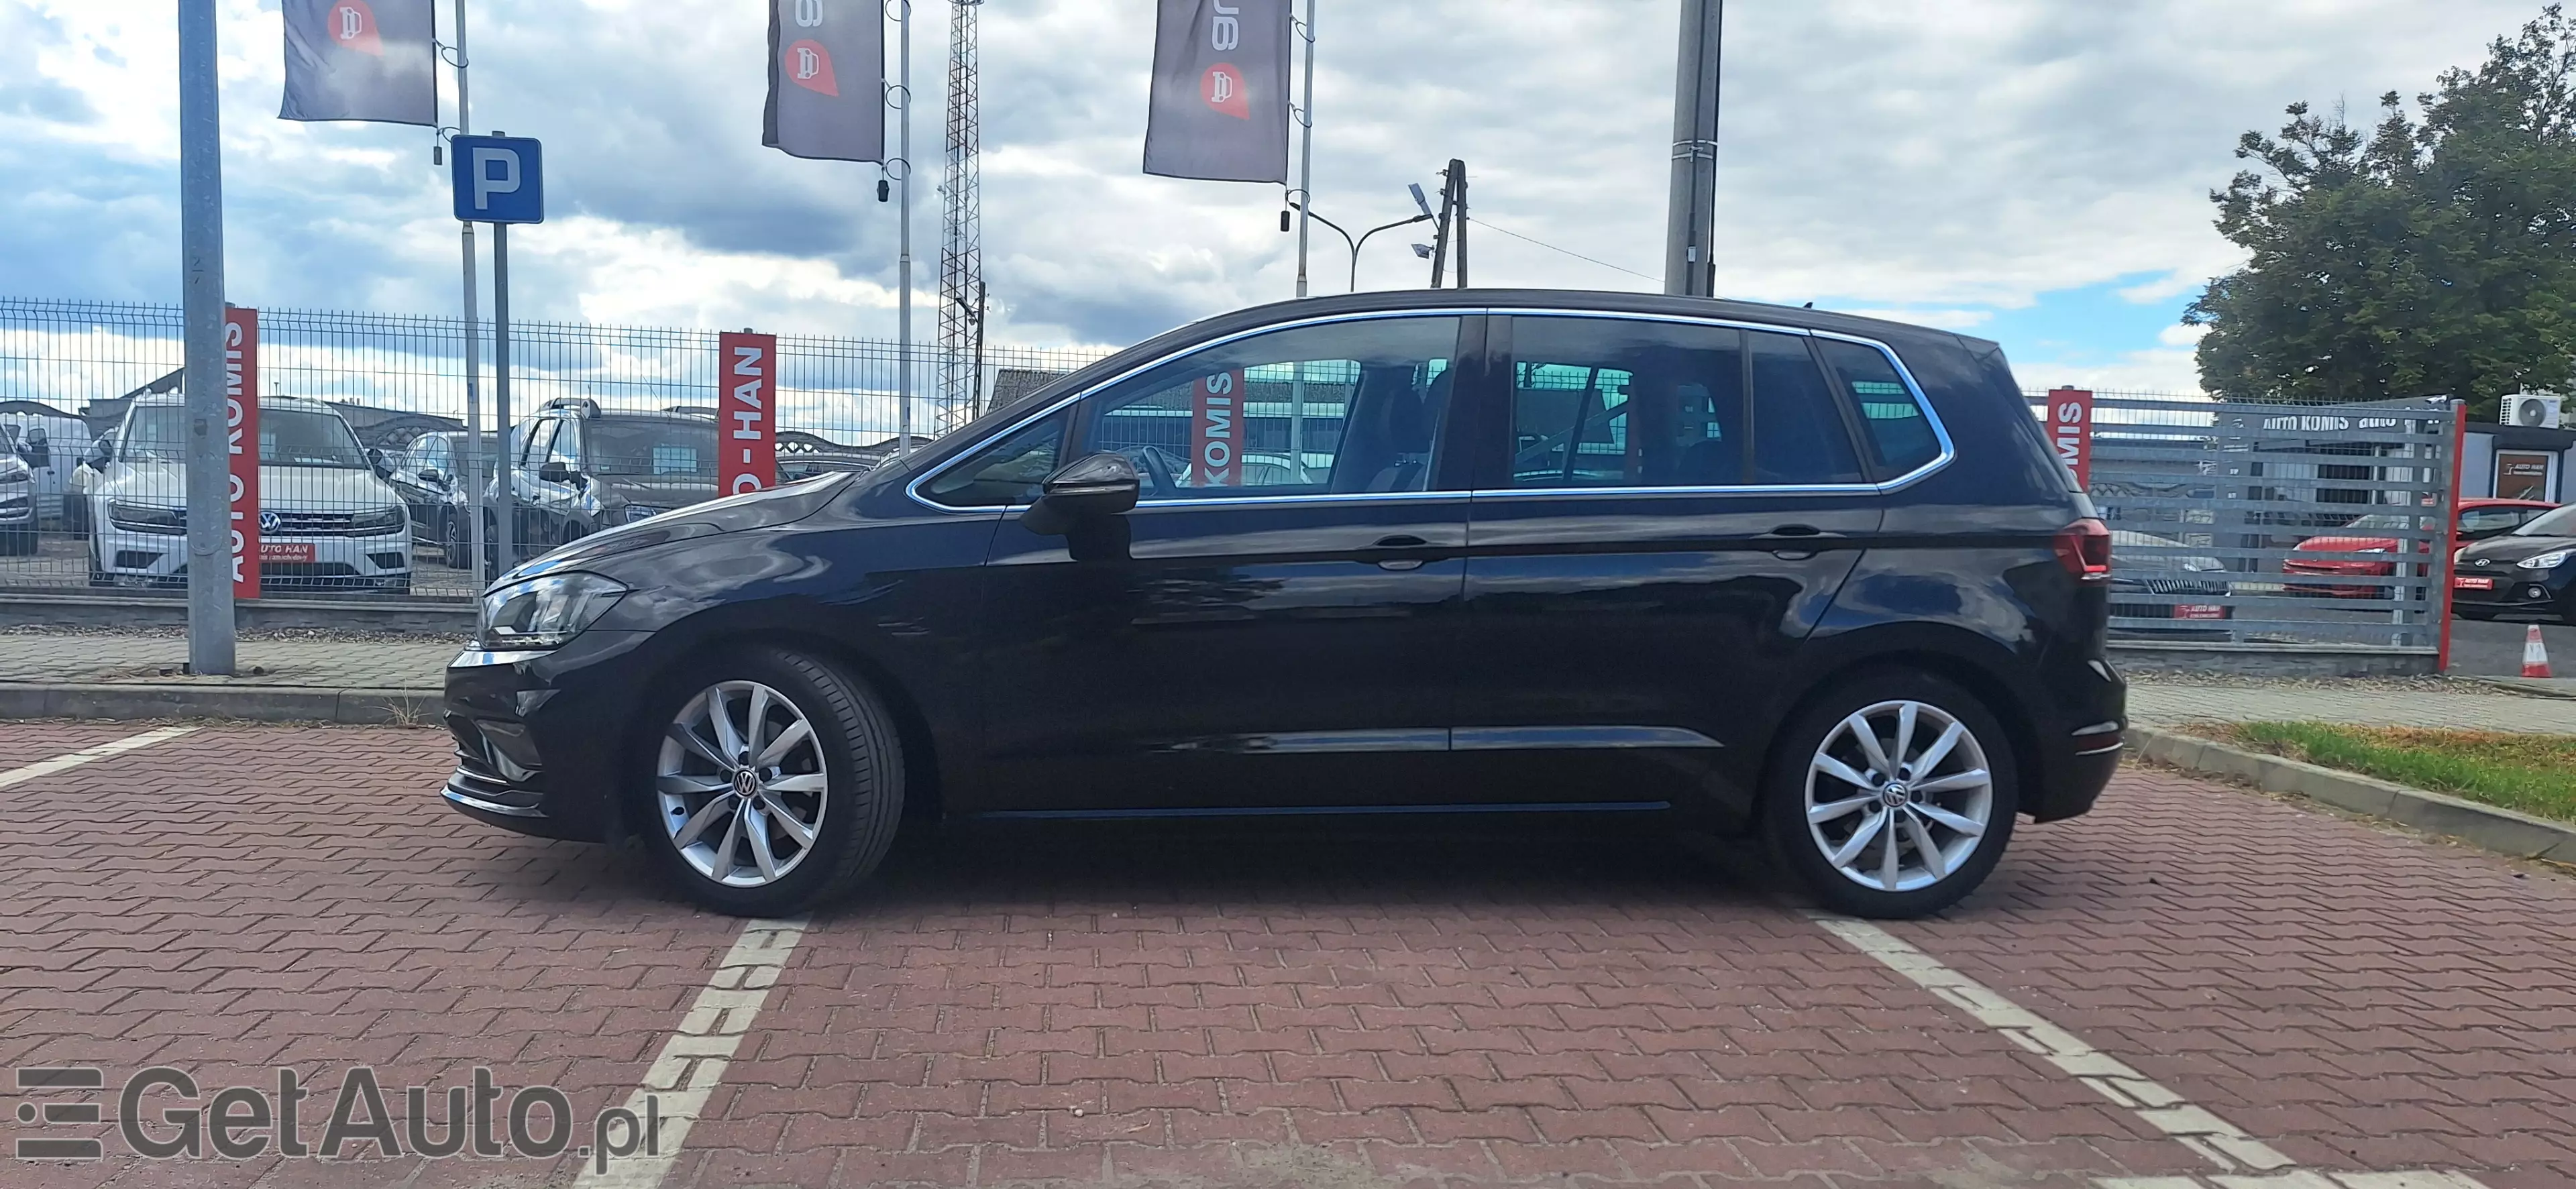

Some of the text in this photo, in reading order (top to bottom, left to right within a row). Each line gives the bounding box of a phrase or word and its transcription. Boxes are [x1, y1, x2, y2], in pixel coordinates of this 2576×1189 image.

[472, 147, 521, 210] P
[1204, 372, 1233, 488] KOMIS
[2057, 402, 2082, 482] MIS
[2301, 415, 2349, 431] KOMIS
[259, 545, 282, 553] UTO
